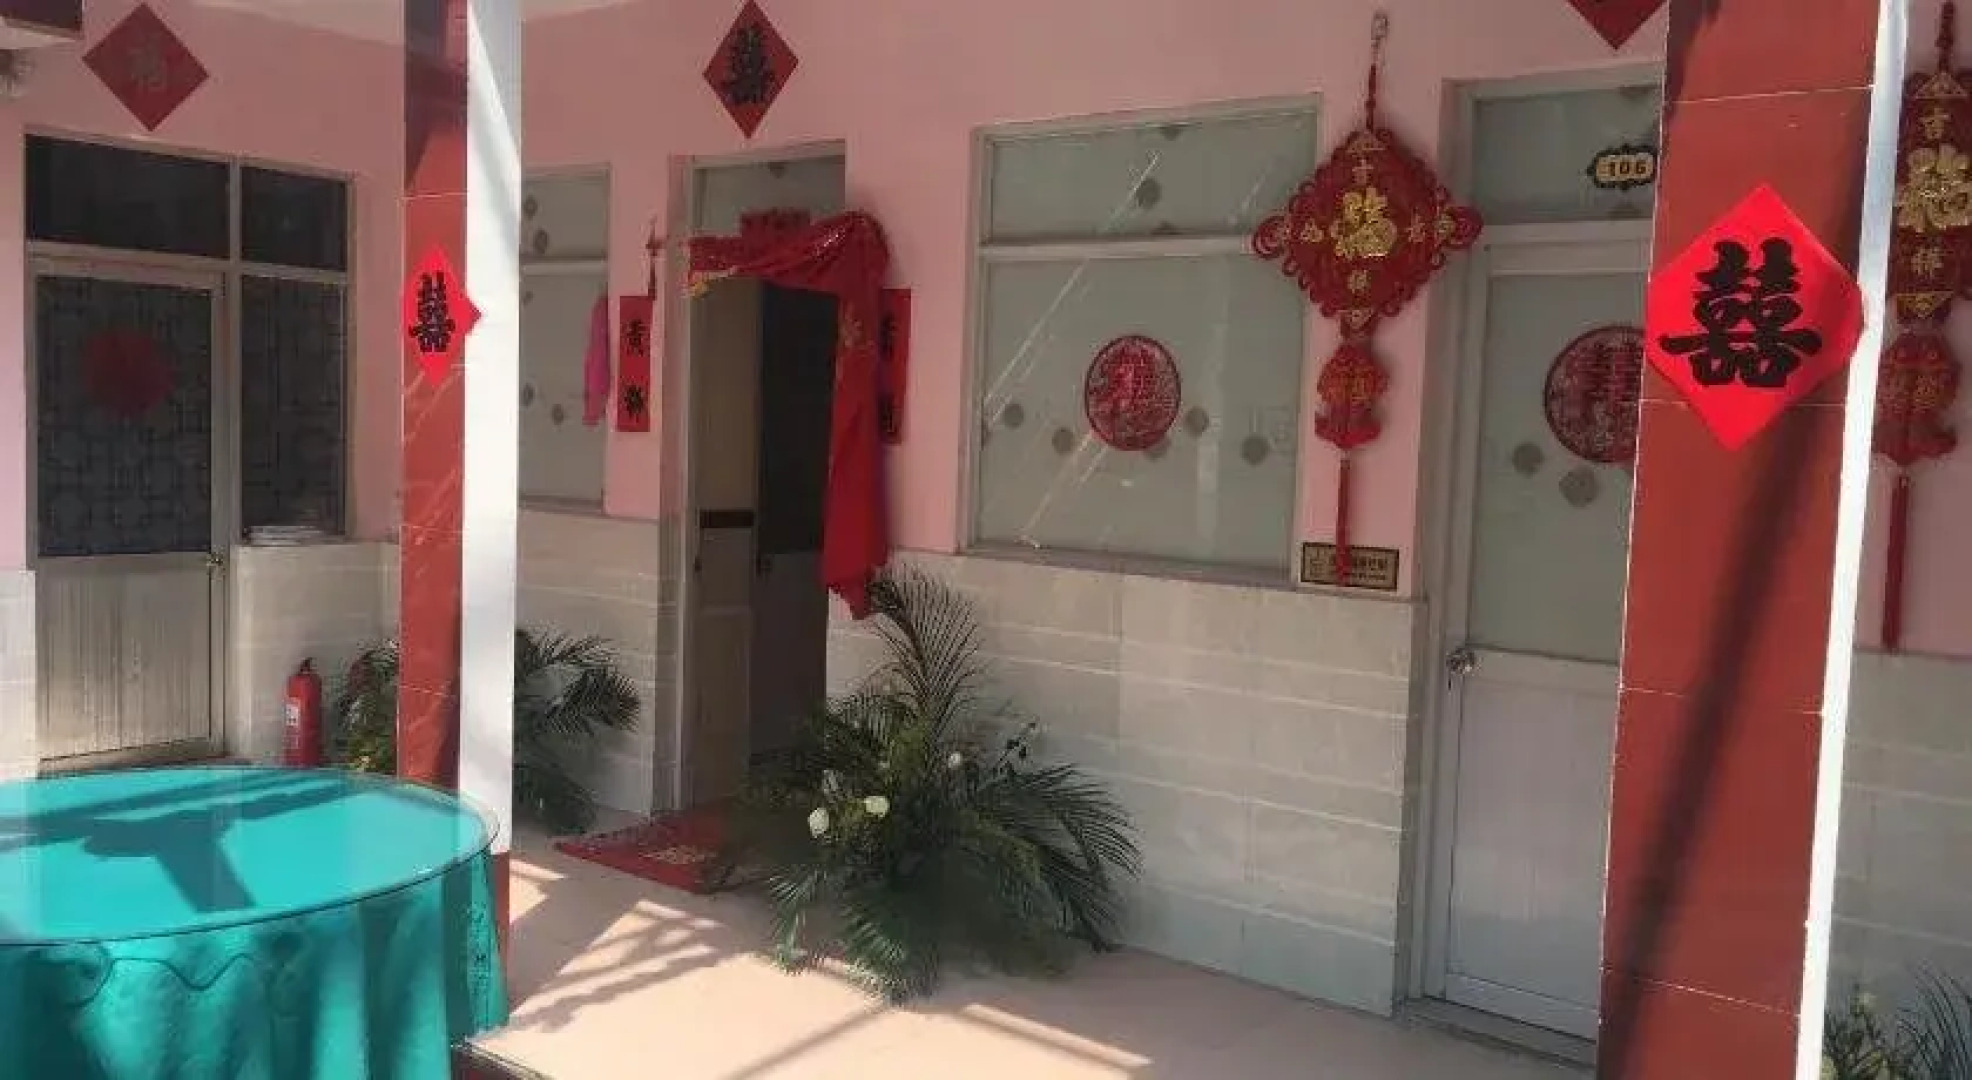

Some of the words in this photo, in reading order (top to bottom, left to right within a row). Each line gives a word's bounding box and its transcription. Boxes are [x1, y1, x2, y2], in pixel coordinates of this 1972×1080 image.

[1919, 106, 1950, 140] 吉
[1609, 160, 1647, 176] 106
[1330, 185, 1398, 260] 福
[1658, 236, 1823, 388] 囍
